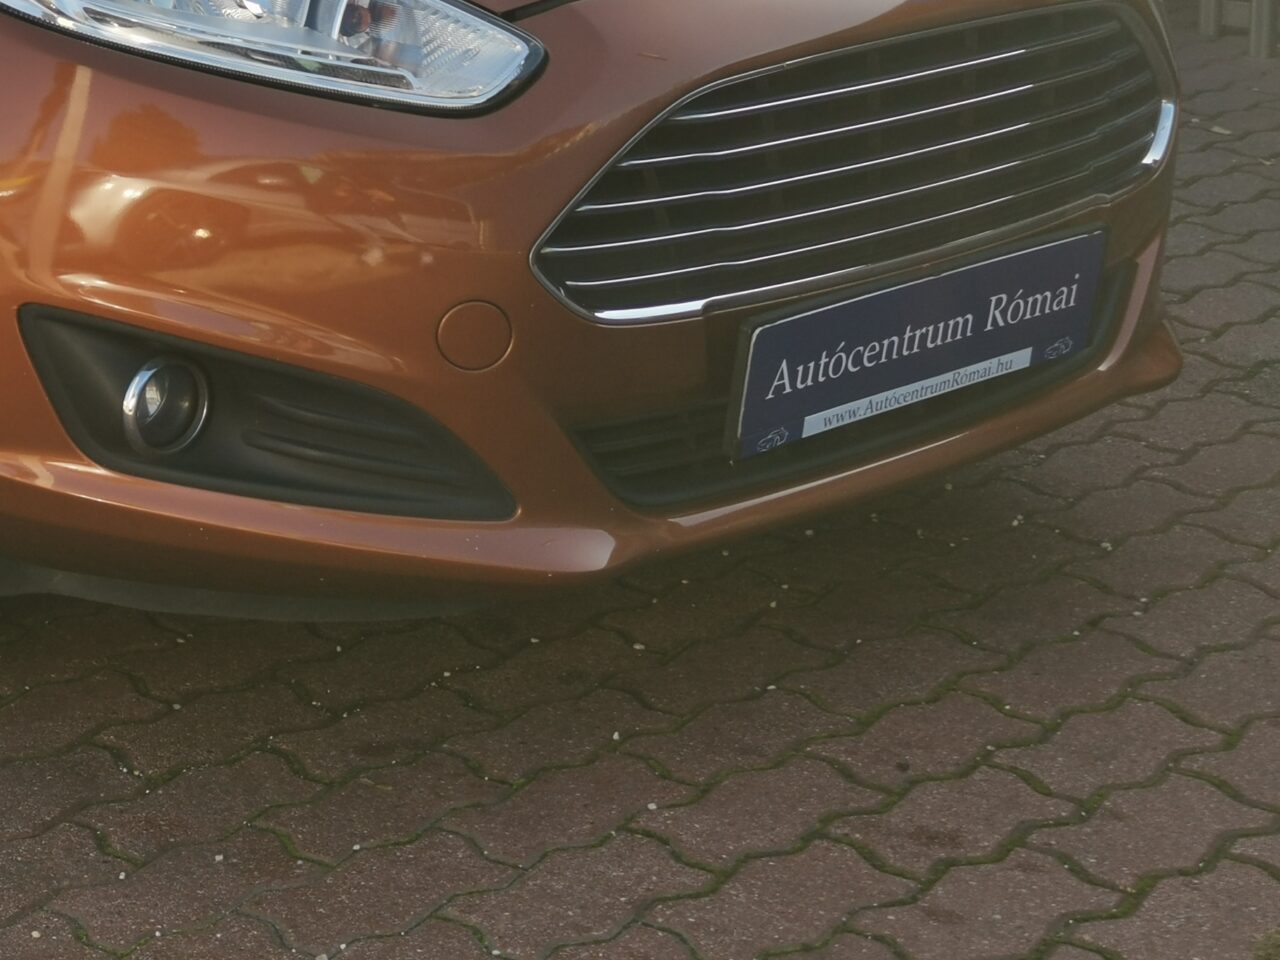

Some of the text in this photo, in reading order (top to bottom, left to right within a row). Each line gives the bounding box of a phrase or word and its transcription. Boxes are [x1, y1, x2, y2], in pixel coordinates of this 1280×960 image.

[765, 273, 1081, 400] Autócentrum Római
[823, 357, 1013, 428] www.AutócentrumRómai.hu
